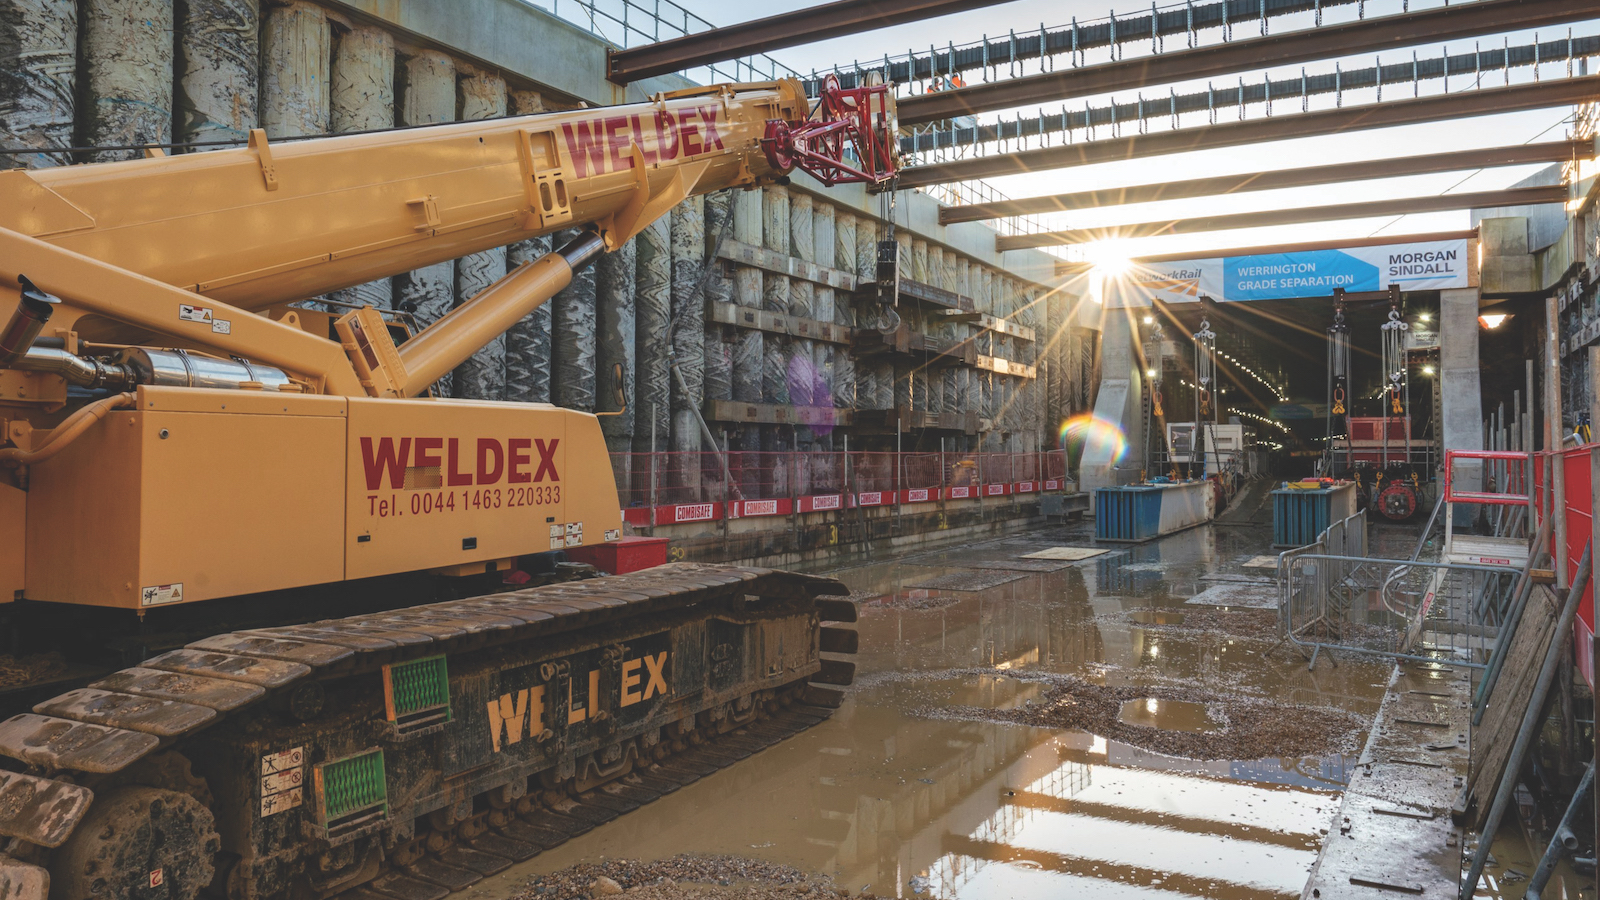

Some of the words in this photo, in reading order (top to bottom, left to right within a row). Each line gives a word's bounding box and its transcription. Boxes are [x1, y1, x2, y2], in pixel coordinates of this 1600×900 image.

[561, 105, 724, 179] WELDEX
[1389, 250, 1457, 265] MORGAN
[1237, 263, 1316, 277] WERRINGTON
[1389, 261, 1454, 276] SINDALL
[1237, 279, 1278, 291] GRADE
[1280, 275, 1354, 289] SEPARATION
[360, 437, 560, 490] WELDEX
[367, 494, 403, 518] Tel.
[411, 491, 455, 515] 0044
[463, 489, 501, 511] 1463
[507, 485, 561, 508] 220333
[814, 495, 838, 509] COMBISAFE
[860, 493, 880, 504] COMBISAFE
[677, 505, 711, 520] COMBISAFE
[746, 501, 775, 515] COMBISAFE
[829, 525, 838, 545] 31
[670, 546, 685, 563] 30
